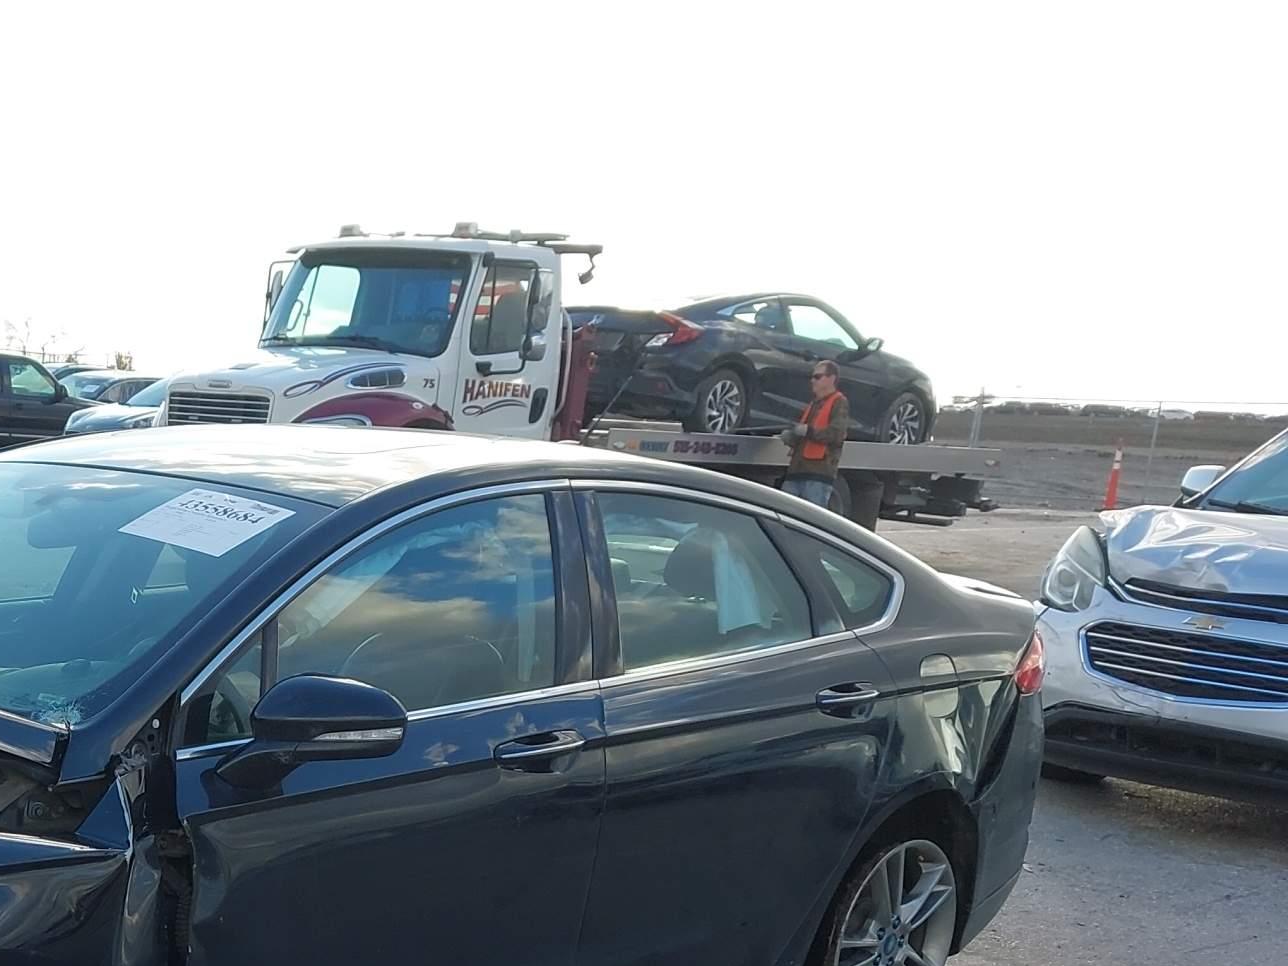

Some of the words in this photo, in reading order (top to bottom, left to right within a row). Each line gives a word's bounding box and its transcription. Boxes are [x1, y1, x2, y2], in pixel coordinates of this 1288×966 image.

[423, 378, 435, 388] 75
[462, 379, 532, 403] HANIFEN
[178, 500, 265, 524] 43558684
